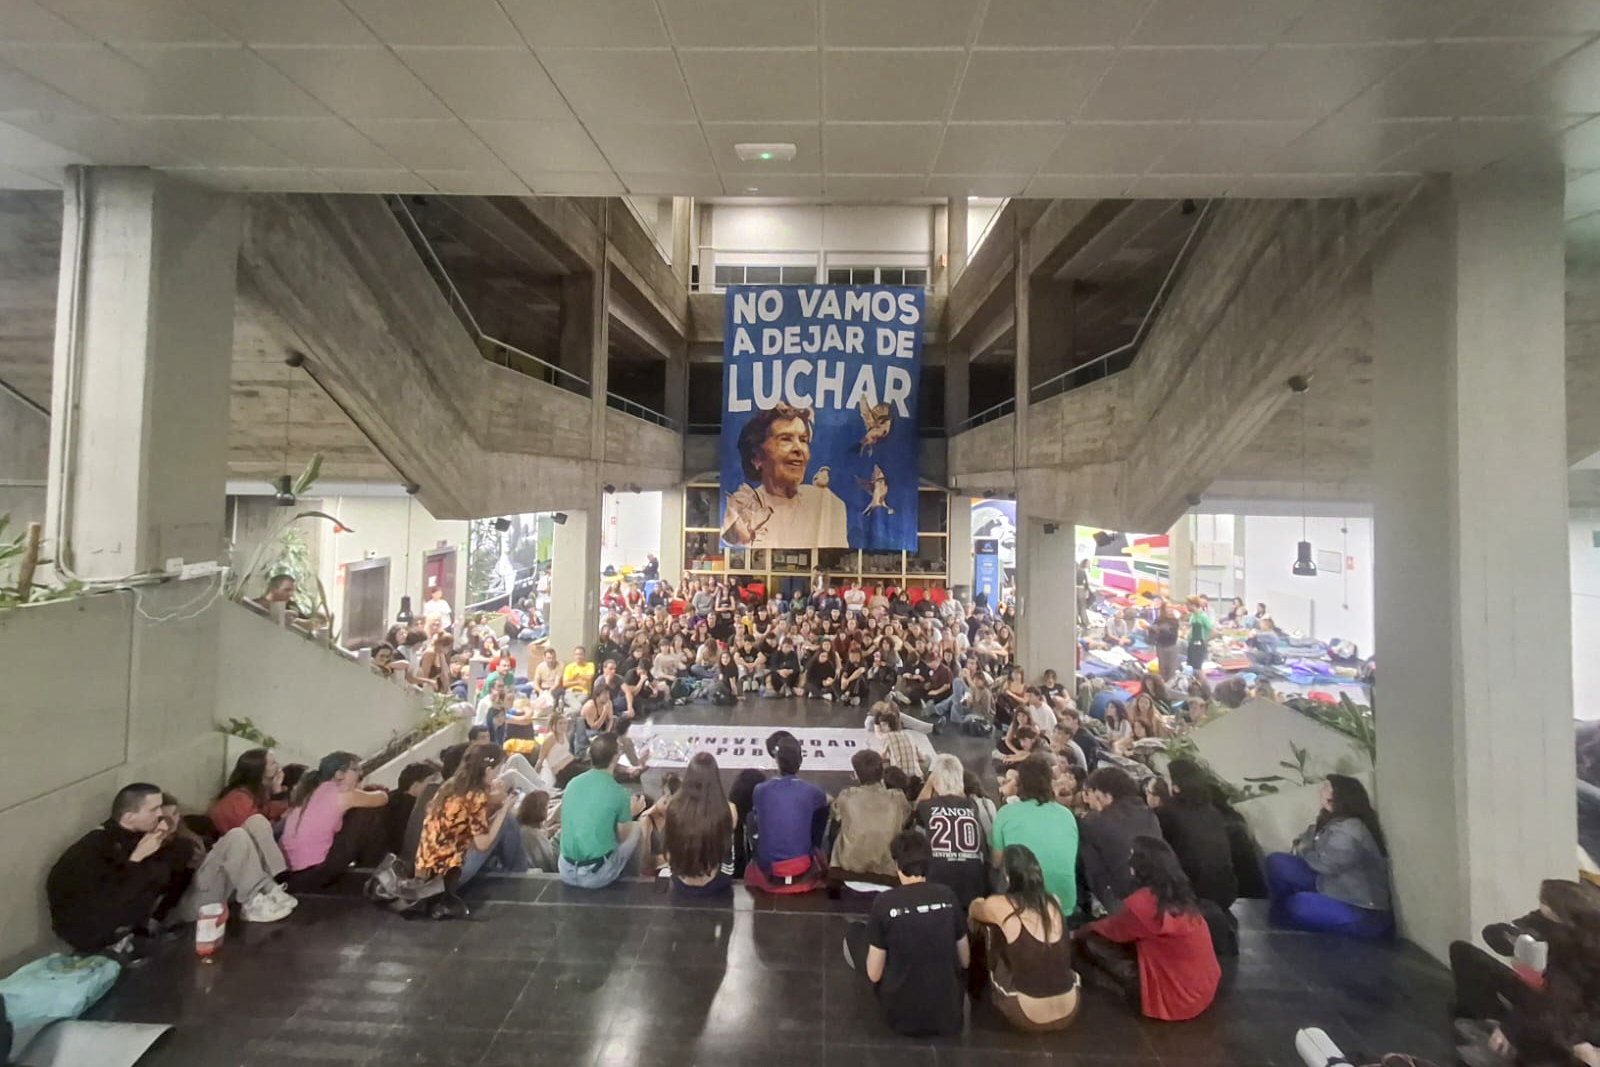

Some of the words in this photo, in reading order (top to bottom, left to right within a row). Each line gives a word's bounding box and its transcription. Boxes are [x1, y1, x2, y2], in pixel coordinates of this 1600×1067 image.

[733, 289, 784, 324] NO
[797, 289, 920, 325] VAMOS
[732, 327, 756, 356] A
[762, 324, 865, 355] DEJAR
[876, 327, 915, 359] DE
[728, 359, 912, 418] LUCHAR
[930, 806, 975, 817] ZANON
[929, 815, 980, 853] 20
